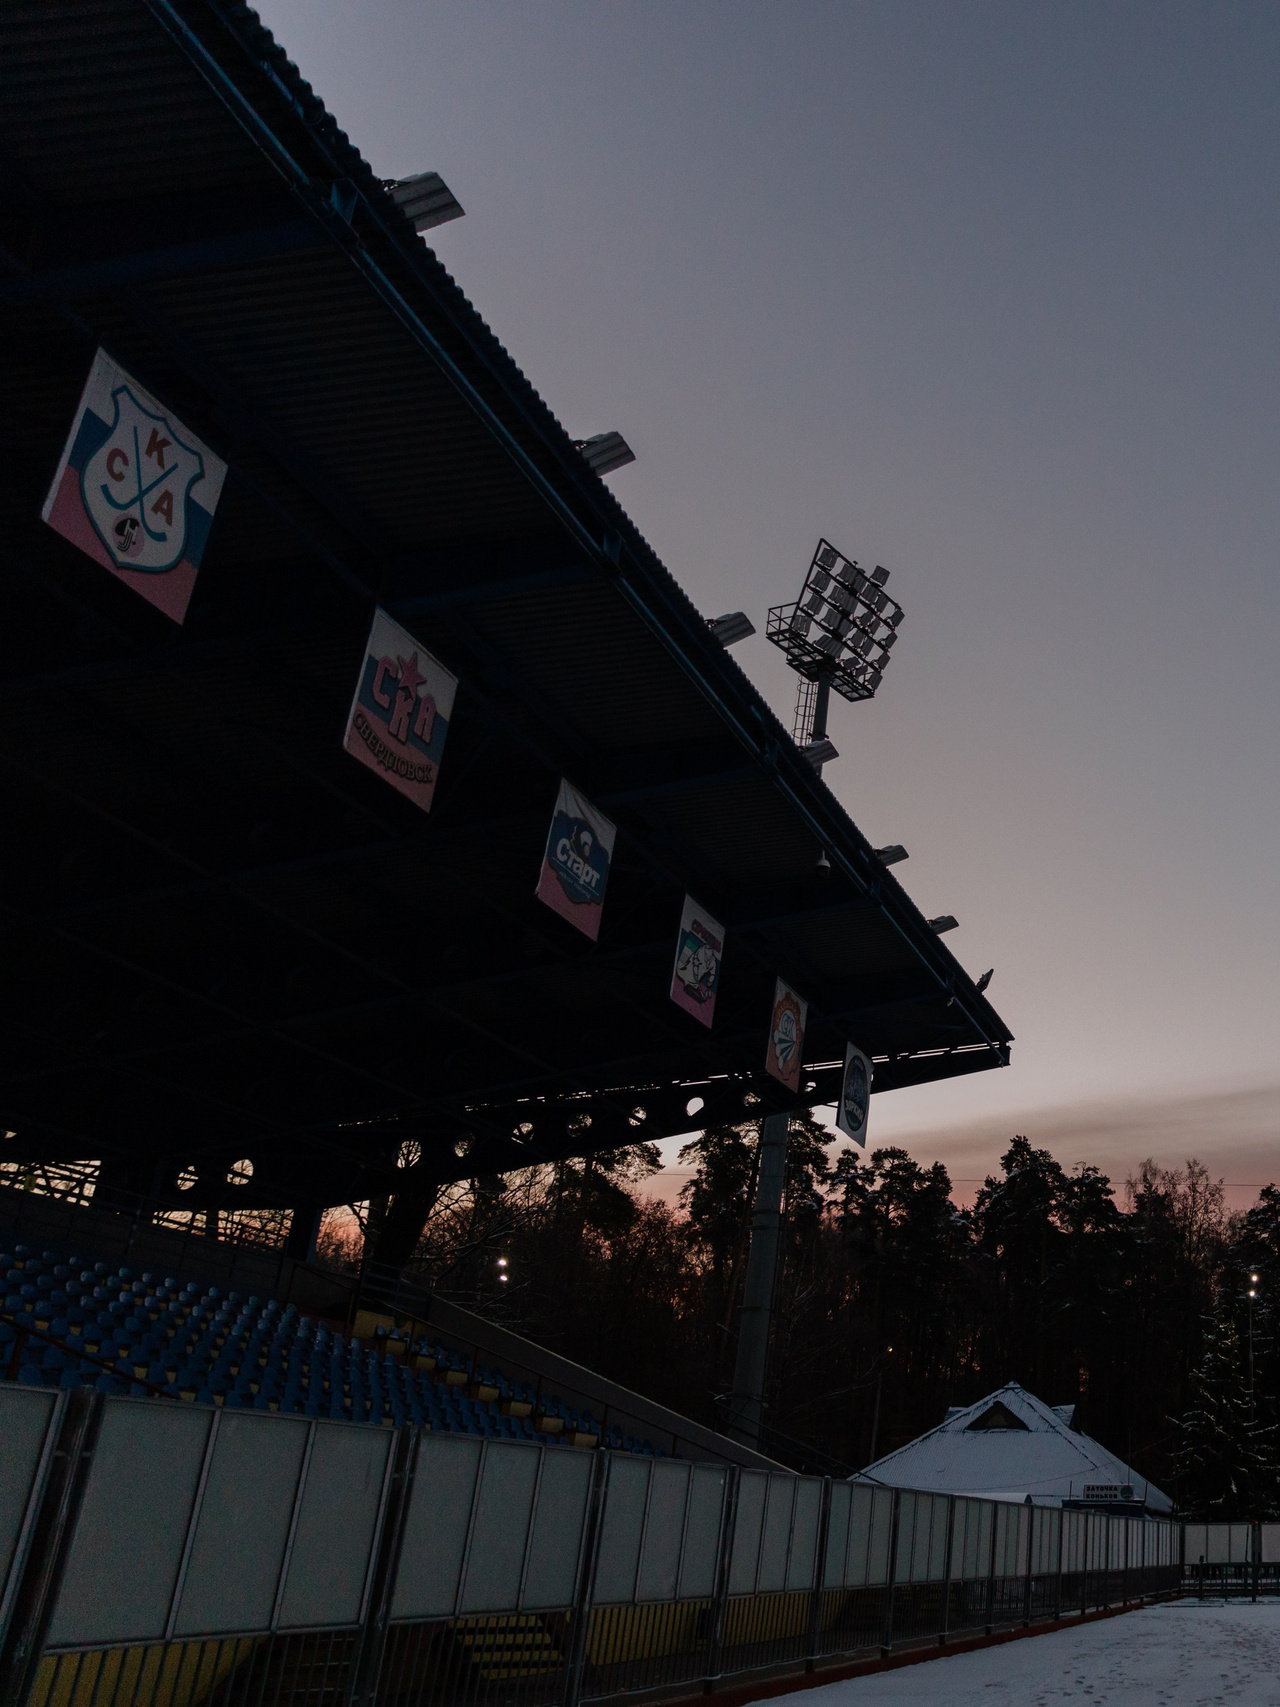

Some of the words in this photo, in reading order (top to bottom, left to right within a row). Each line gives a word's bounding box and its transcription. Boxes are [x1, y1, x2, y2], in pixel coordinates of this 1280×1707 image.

[372, 656, 437, 744] СКА
[353, 711, 433, 783] СВЕРДЛОВСК
[556, 837, 600, 887] Старт
